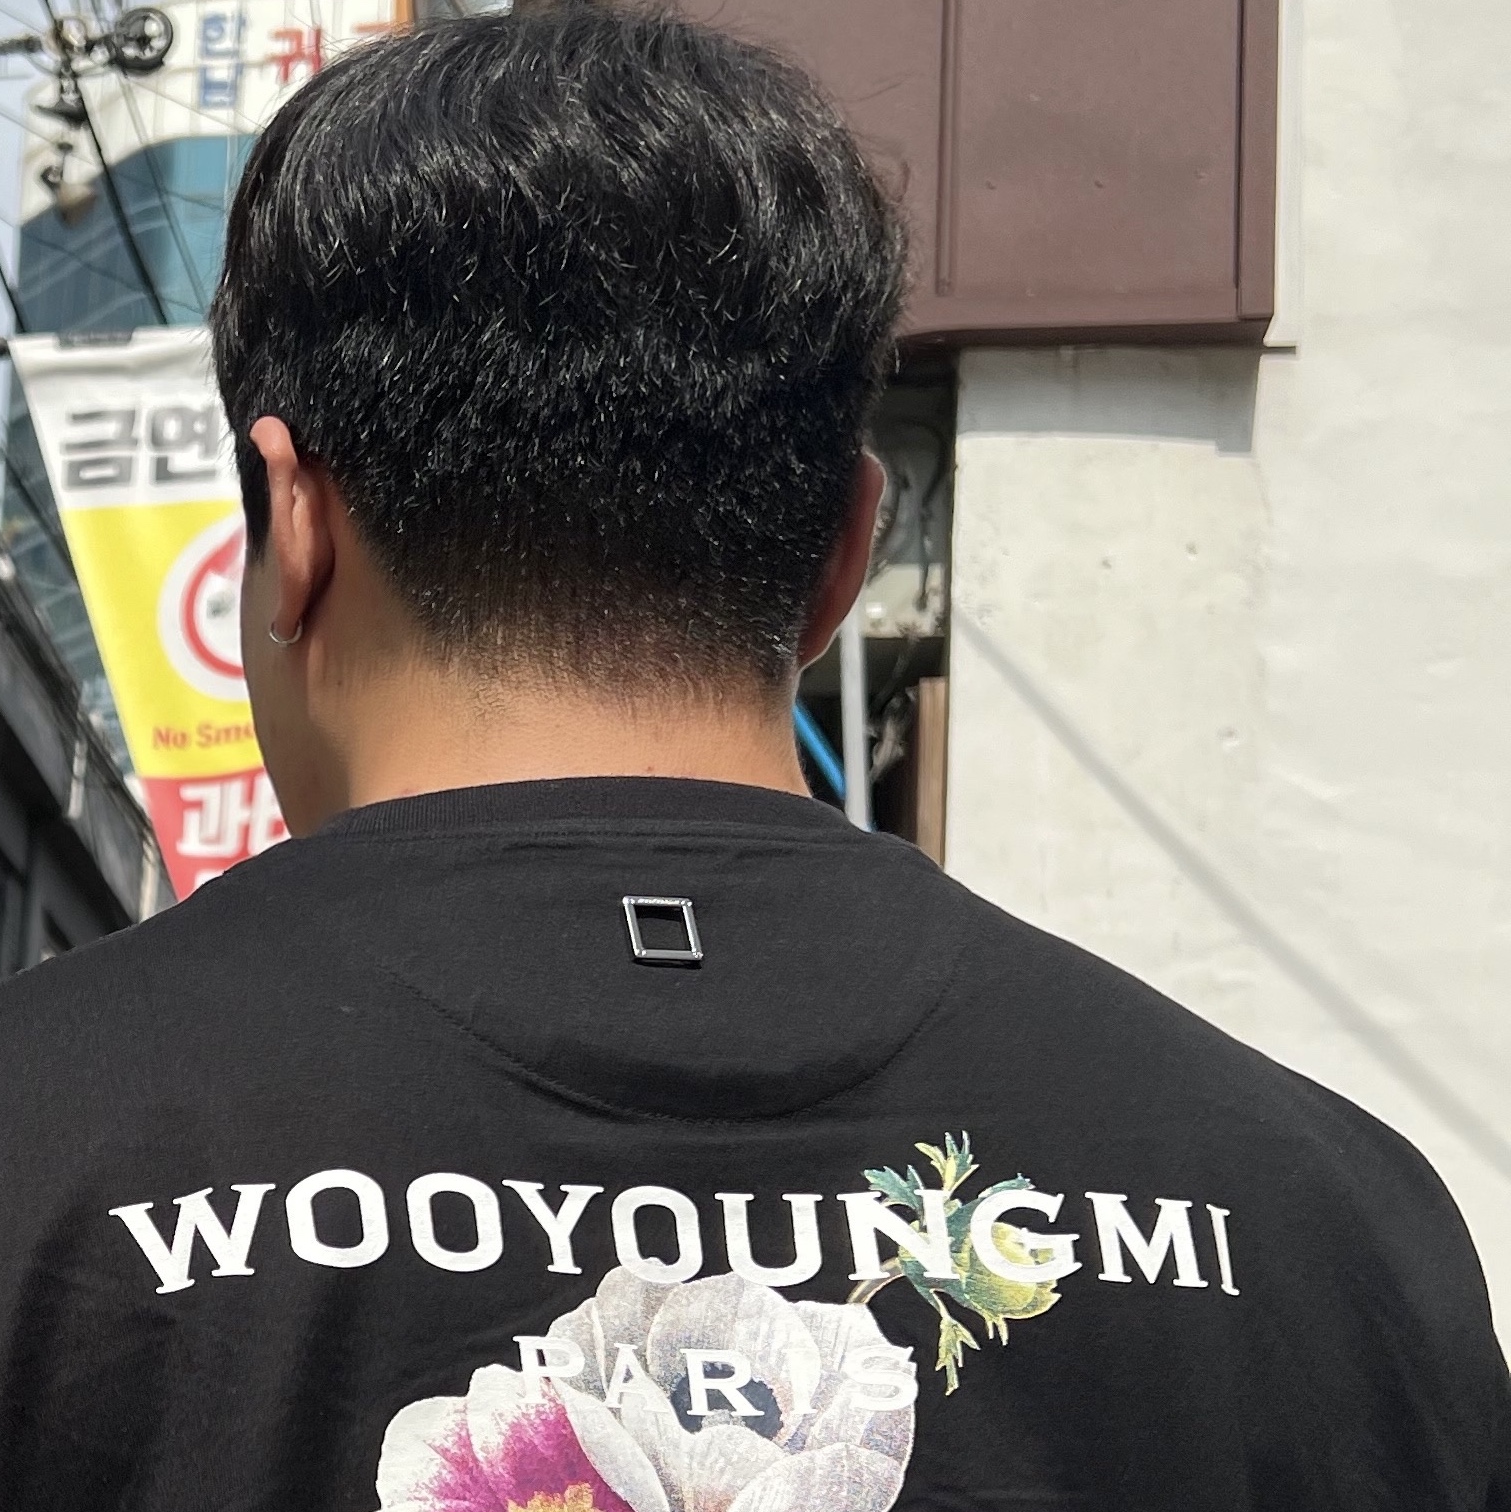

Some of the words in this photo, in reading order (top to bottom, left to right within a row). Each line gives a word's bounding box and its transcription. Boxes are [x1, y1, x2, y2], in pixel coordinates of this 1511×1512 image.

[62, 405, 220, 490] 금연
[152, 725, 188, 749] No
[108, 1168, 1240, 1296] WOOYOUNGMI
[512, 1335, 919, 1418] PARIS
